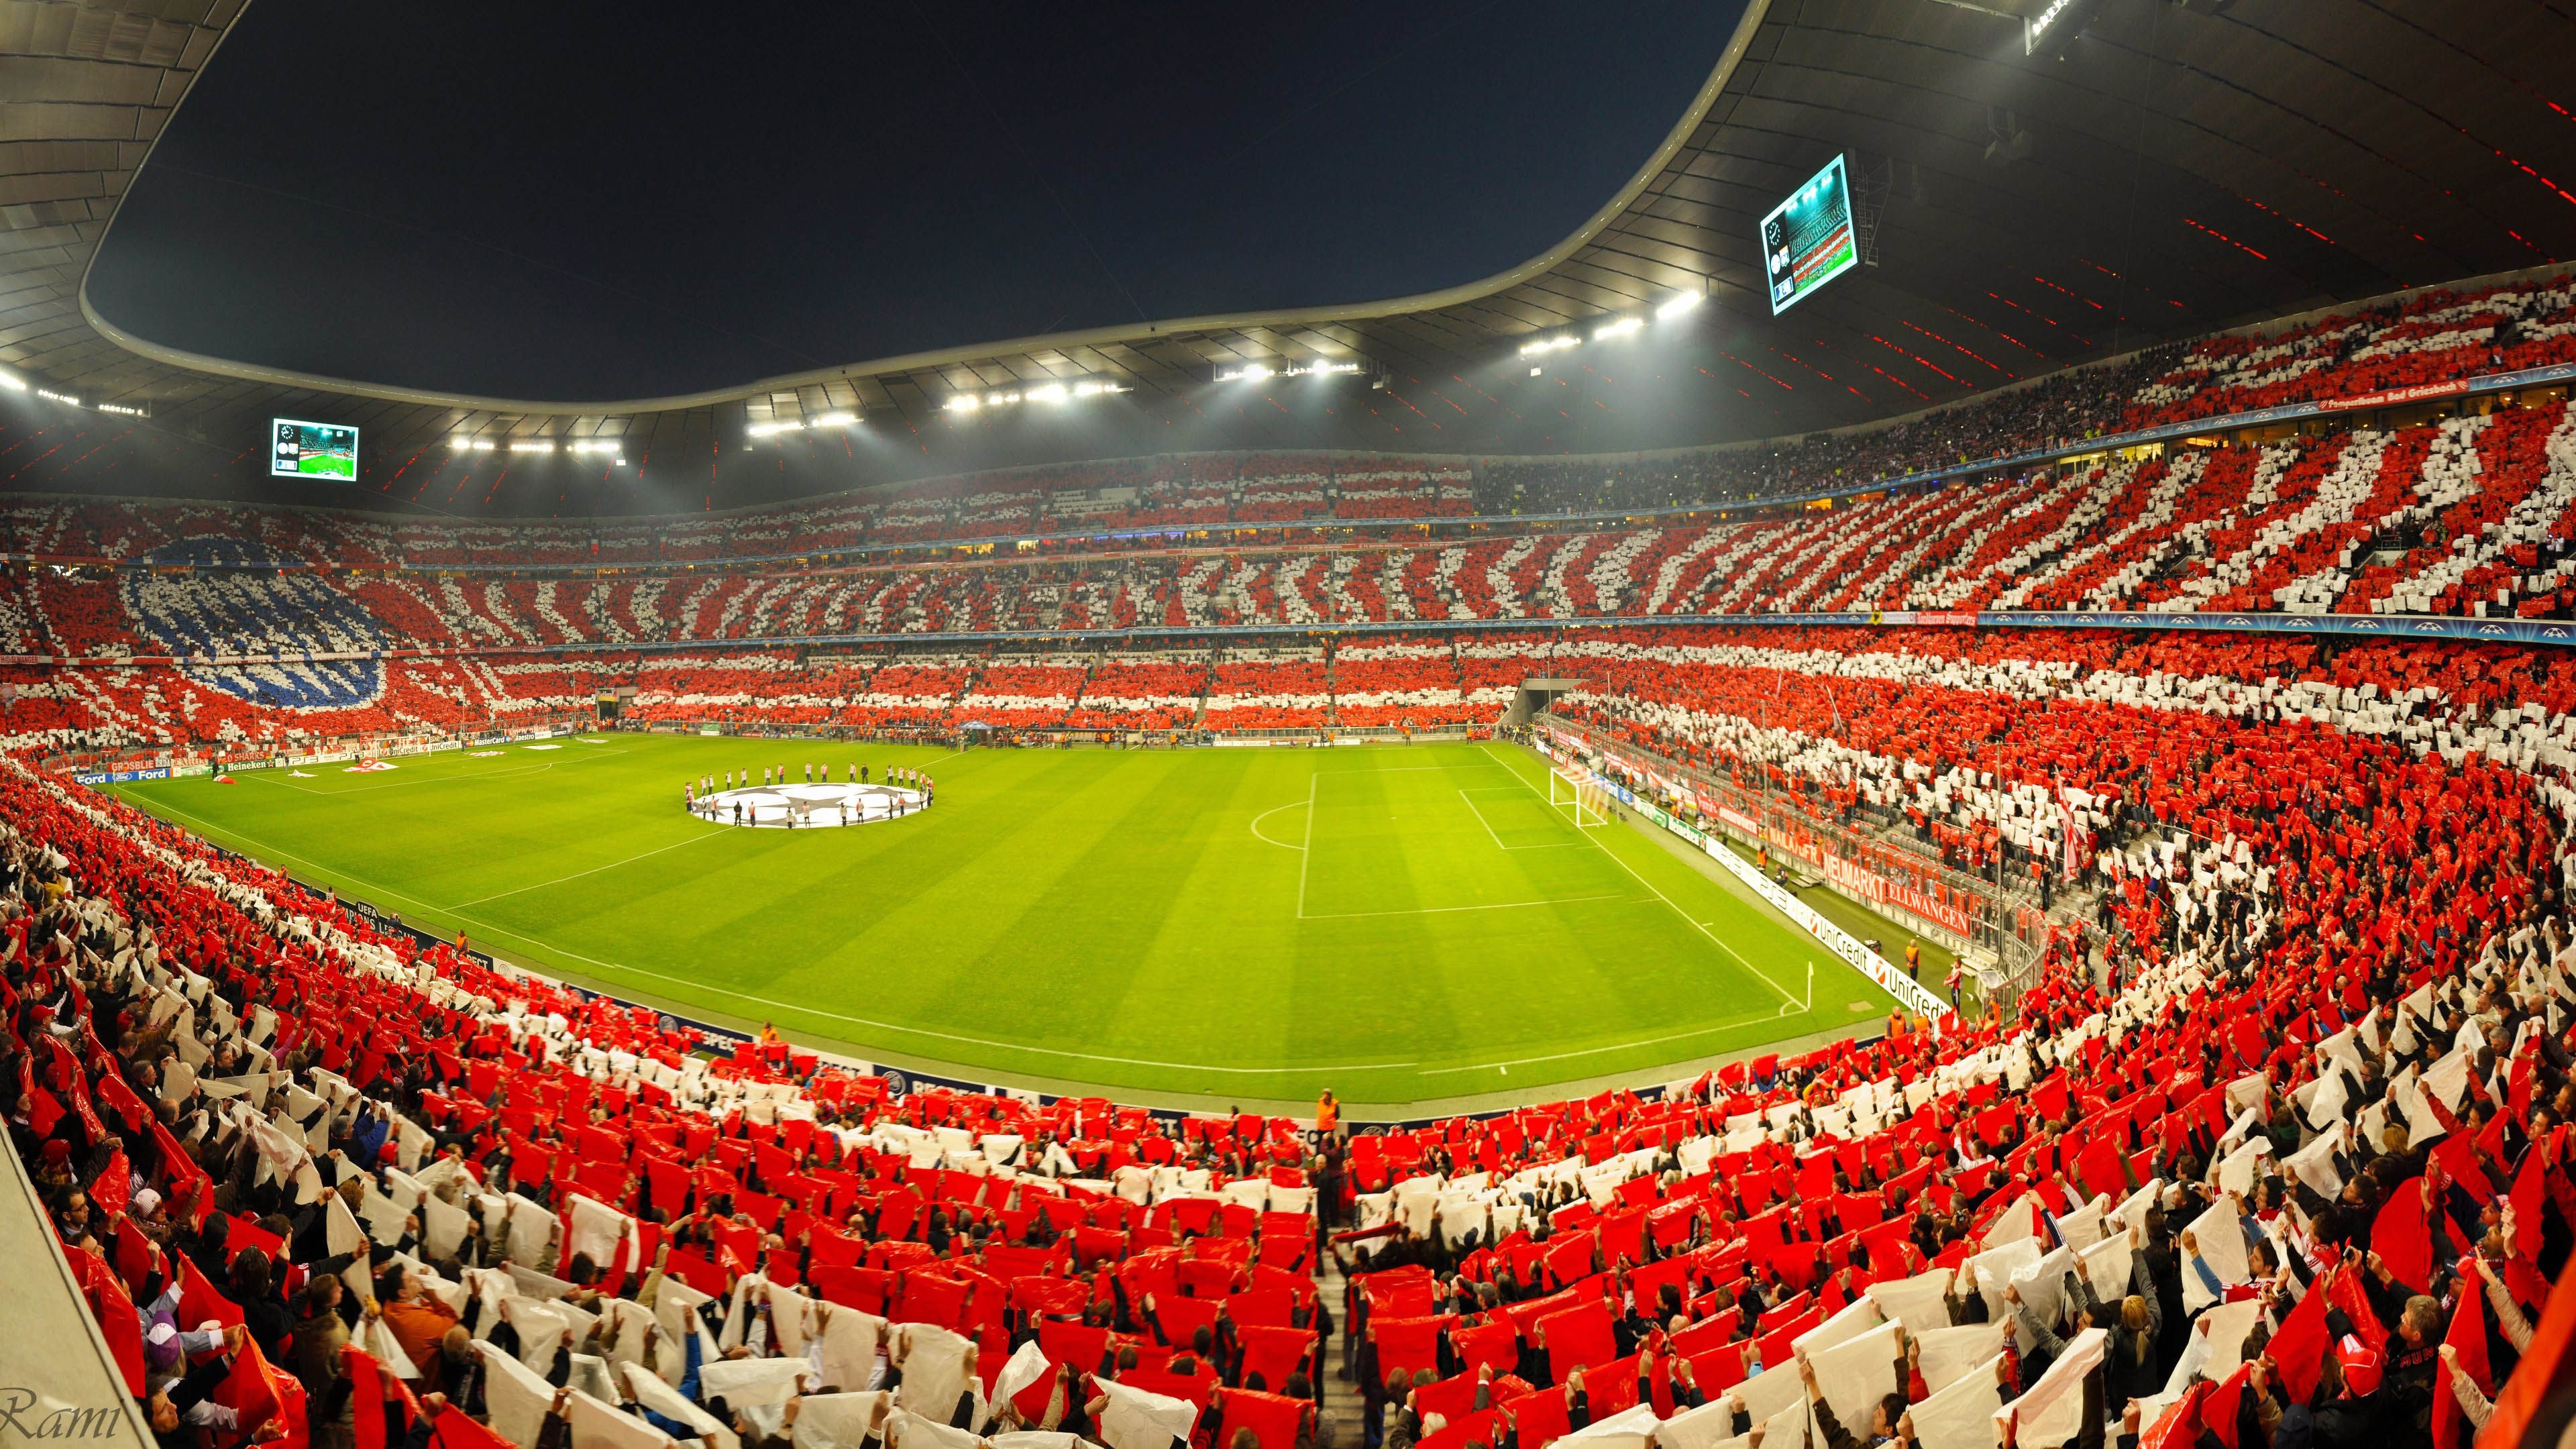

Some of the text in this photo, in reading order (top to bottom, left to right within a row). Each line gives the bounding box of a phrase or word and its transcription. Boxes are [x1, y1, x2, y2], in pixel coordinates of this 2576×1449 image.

[2387, 390, 2406, 402] Bad
[474, 737, 504, 746] MasterCard
[235, 751, 264, 762] SHARKS
[292, 755, 319, 764] PS3
[227, 759, 266, 771] Heineken
[77, 773, 106, 785] Ford
[138, 769, 166, 780] Ford
[1823, 852, 1886, 903] NEUMARKT
[1760, 876, 1787, 910] PS3
[358, 903, 377, 918] UEFA
[1889, 881, 1969, 932] ELLWANGEN
[1820, 920, 1867, 971] UniCredit
[2400, 1345, 2434, 1368] MUN
